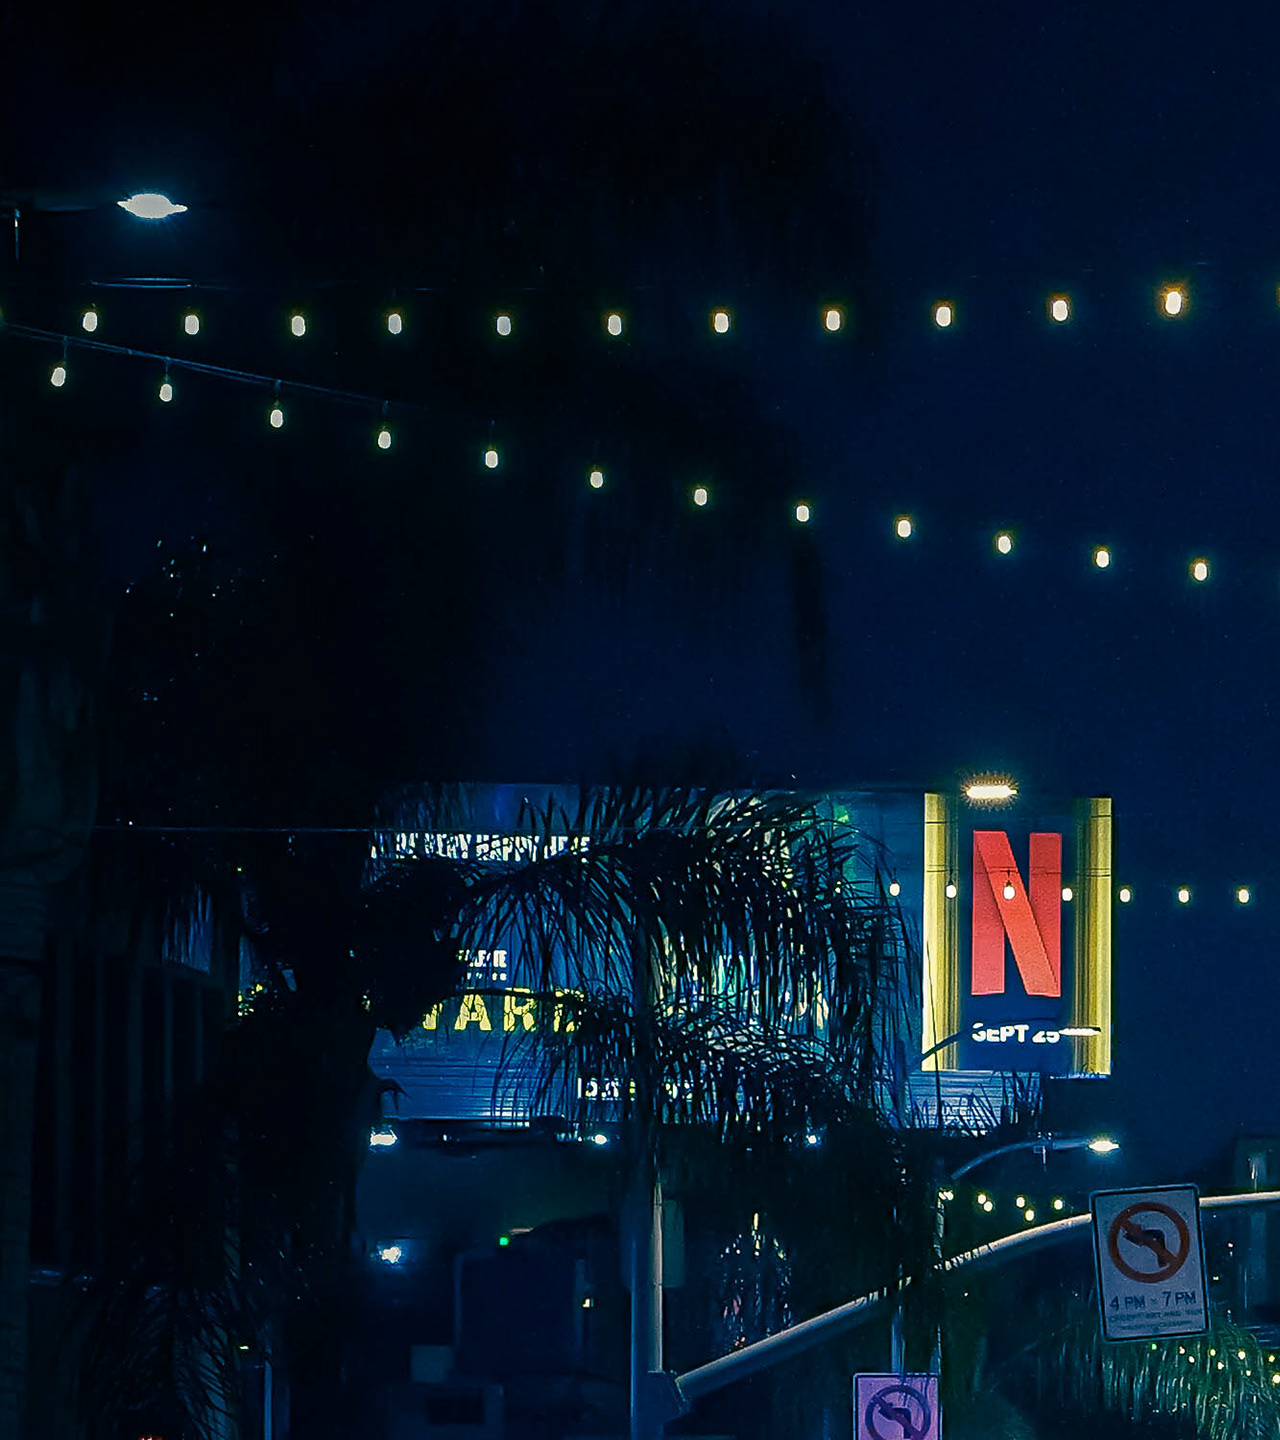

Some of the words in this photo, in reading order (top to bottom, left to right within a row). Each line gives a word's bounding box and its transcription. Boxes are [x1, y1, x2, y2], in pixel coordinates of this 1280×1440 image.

[970, 829, 1062, 997] N
[971, 1022, 1030, 1043] SEPT
[1109, 1295, 1119, 1311] 4
[1162, 1291, 1171, 1306] 7
[1175, 1290, 1197, 1305] PM
